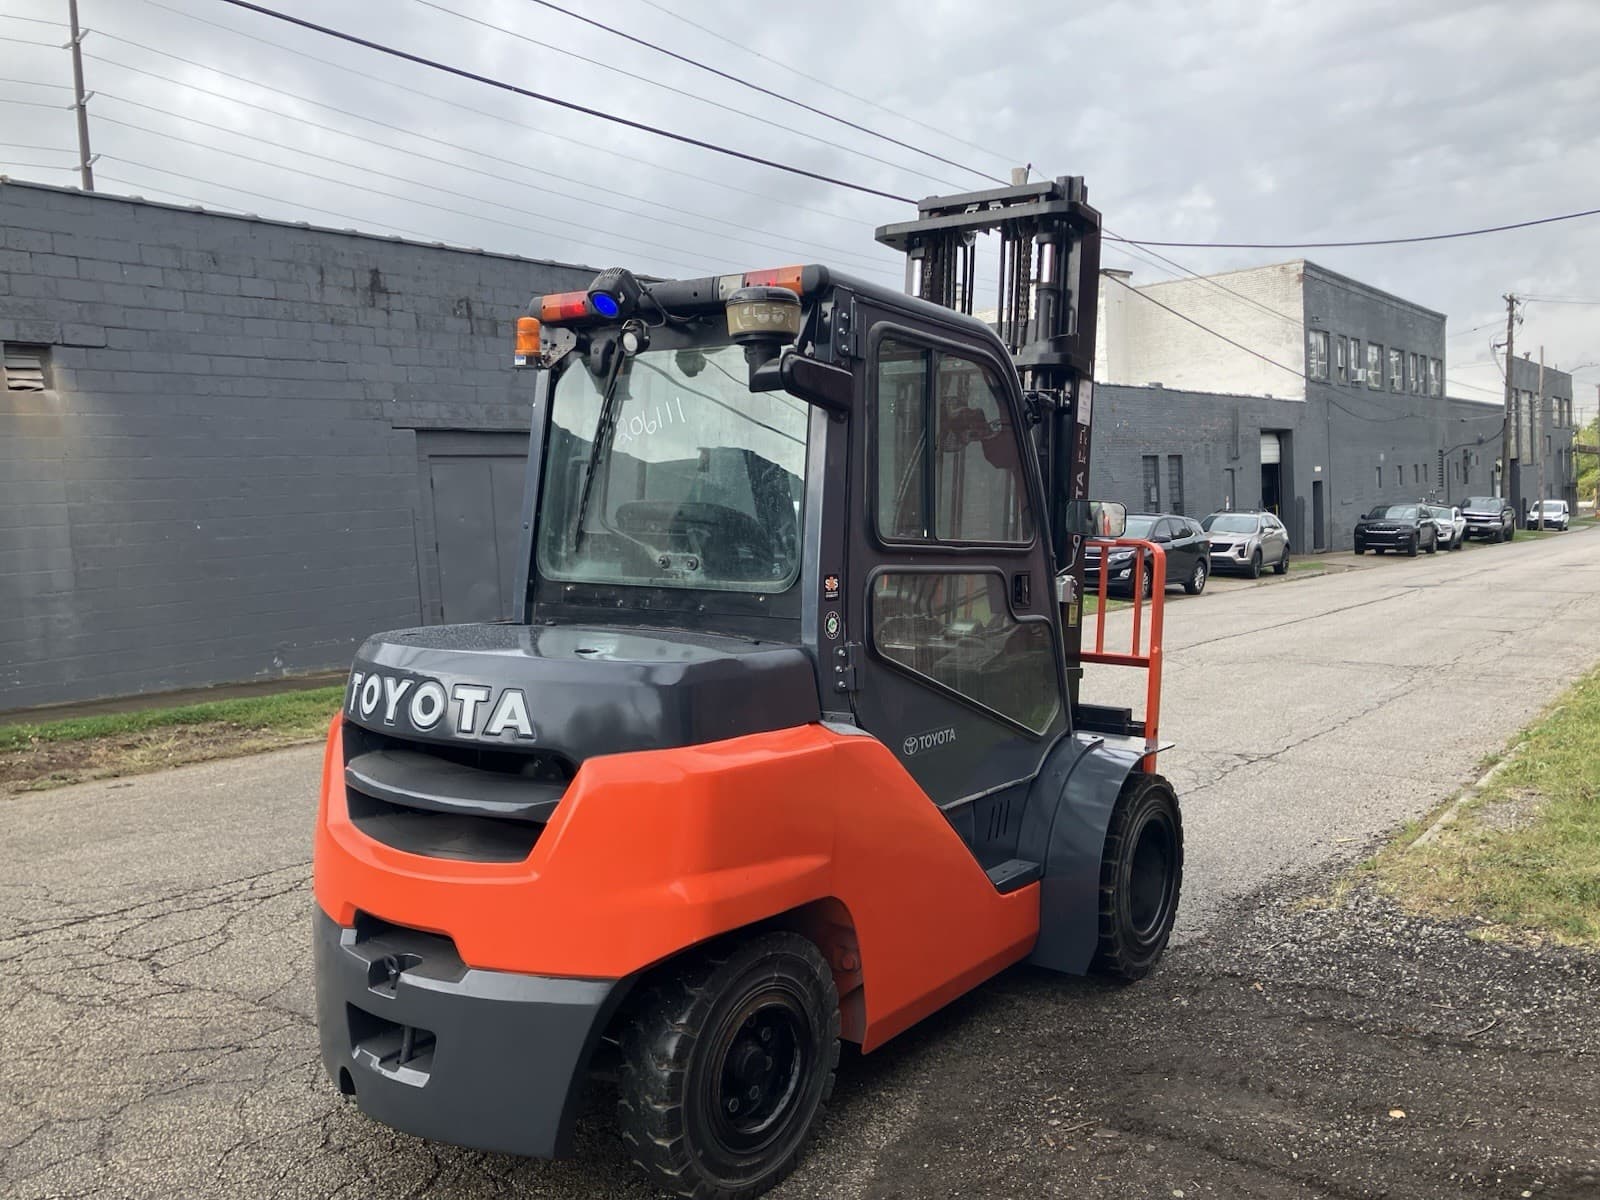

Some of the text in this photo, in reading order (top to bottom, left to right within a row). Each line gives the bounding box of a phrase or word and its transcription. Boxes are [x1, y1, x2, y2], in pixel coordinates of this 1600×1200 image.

[616, 397, 686, 441] 206111
[349, 672, 535, 738] TOYOTA
[919, 728, 956, 749] TOYOTA
